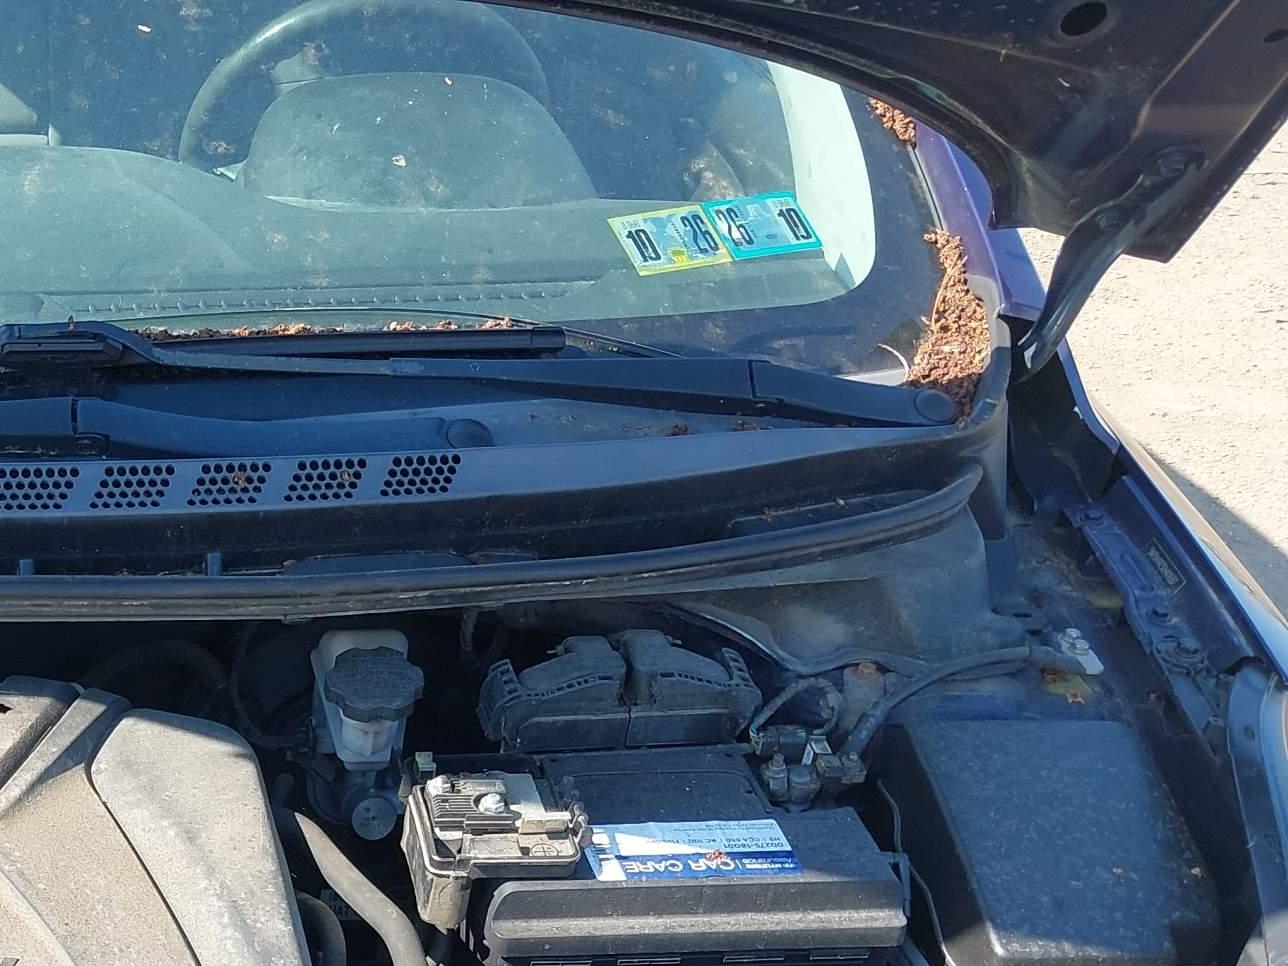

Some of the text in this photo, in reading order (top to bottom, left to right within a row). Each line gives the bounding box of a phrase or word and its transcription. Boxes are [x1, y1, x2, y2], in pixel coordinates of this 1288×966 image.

[625, 228, 662, 263] 10
[680, 214, 719, 253] 26
[777, 207, 813, 241] 10
[621, 857, 735, 873] CAR CARE
